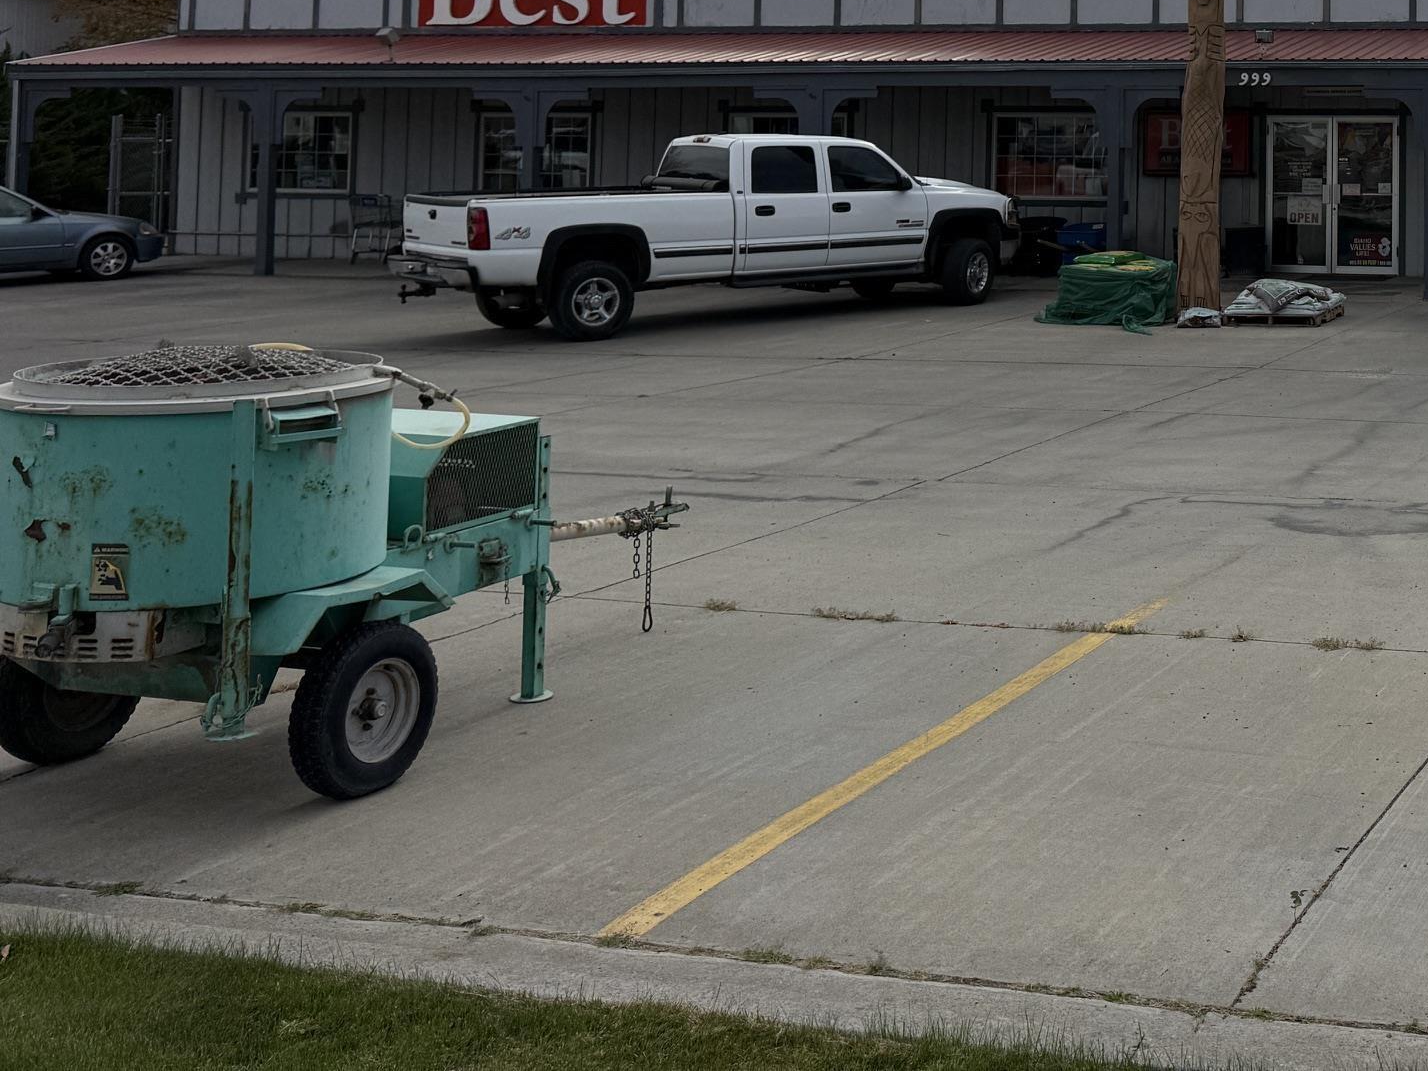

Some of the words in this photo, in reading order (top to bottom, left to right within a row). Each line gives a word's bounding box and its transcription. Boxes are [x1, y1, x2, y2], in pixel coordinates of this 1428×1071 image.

[1238, 72, 1272, 86] 999
[1289, 212, 1319, 224] OPEN
[1349, 243, 1376, 251] VALUES
